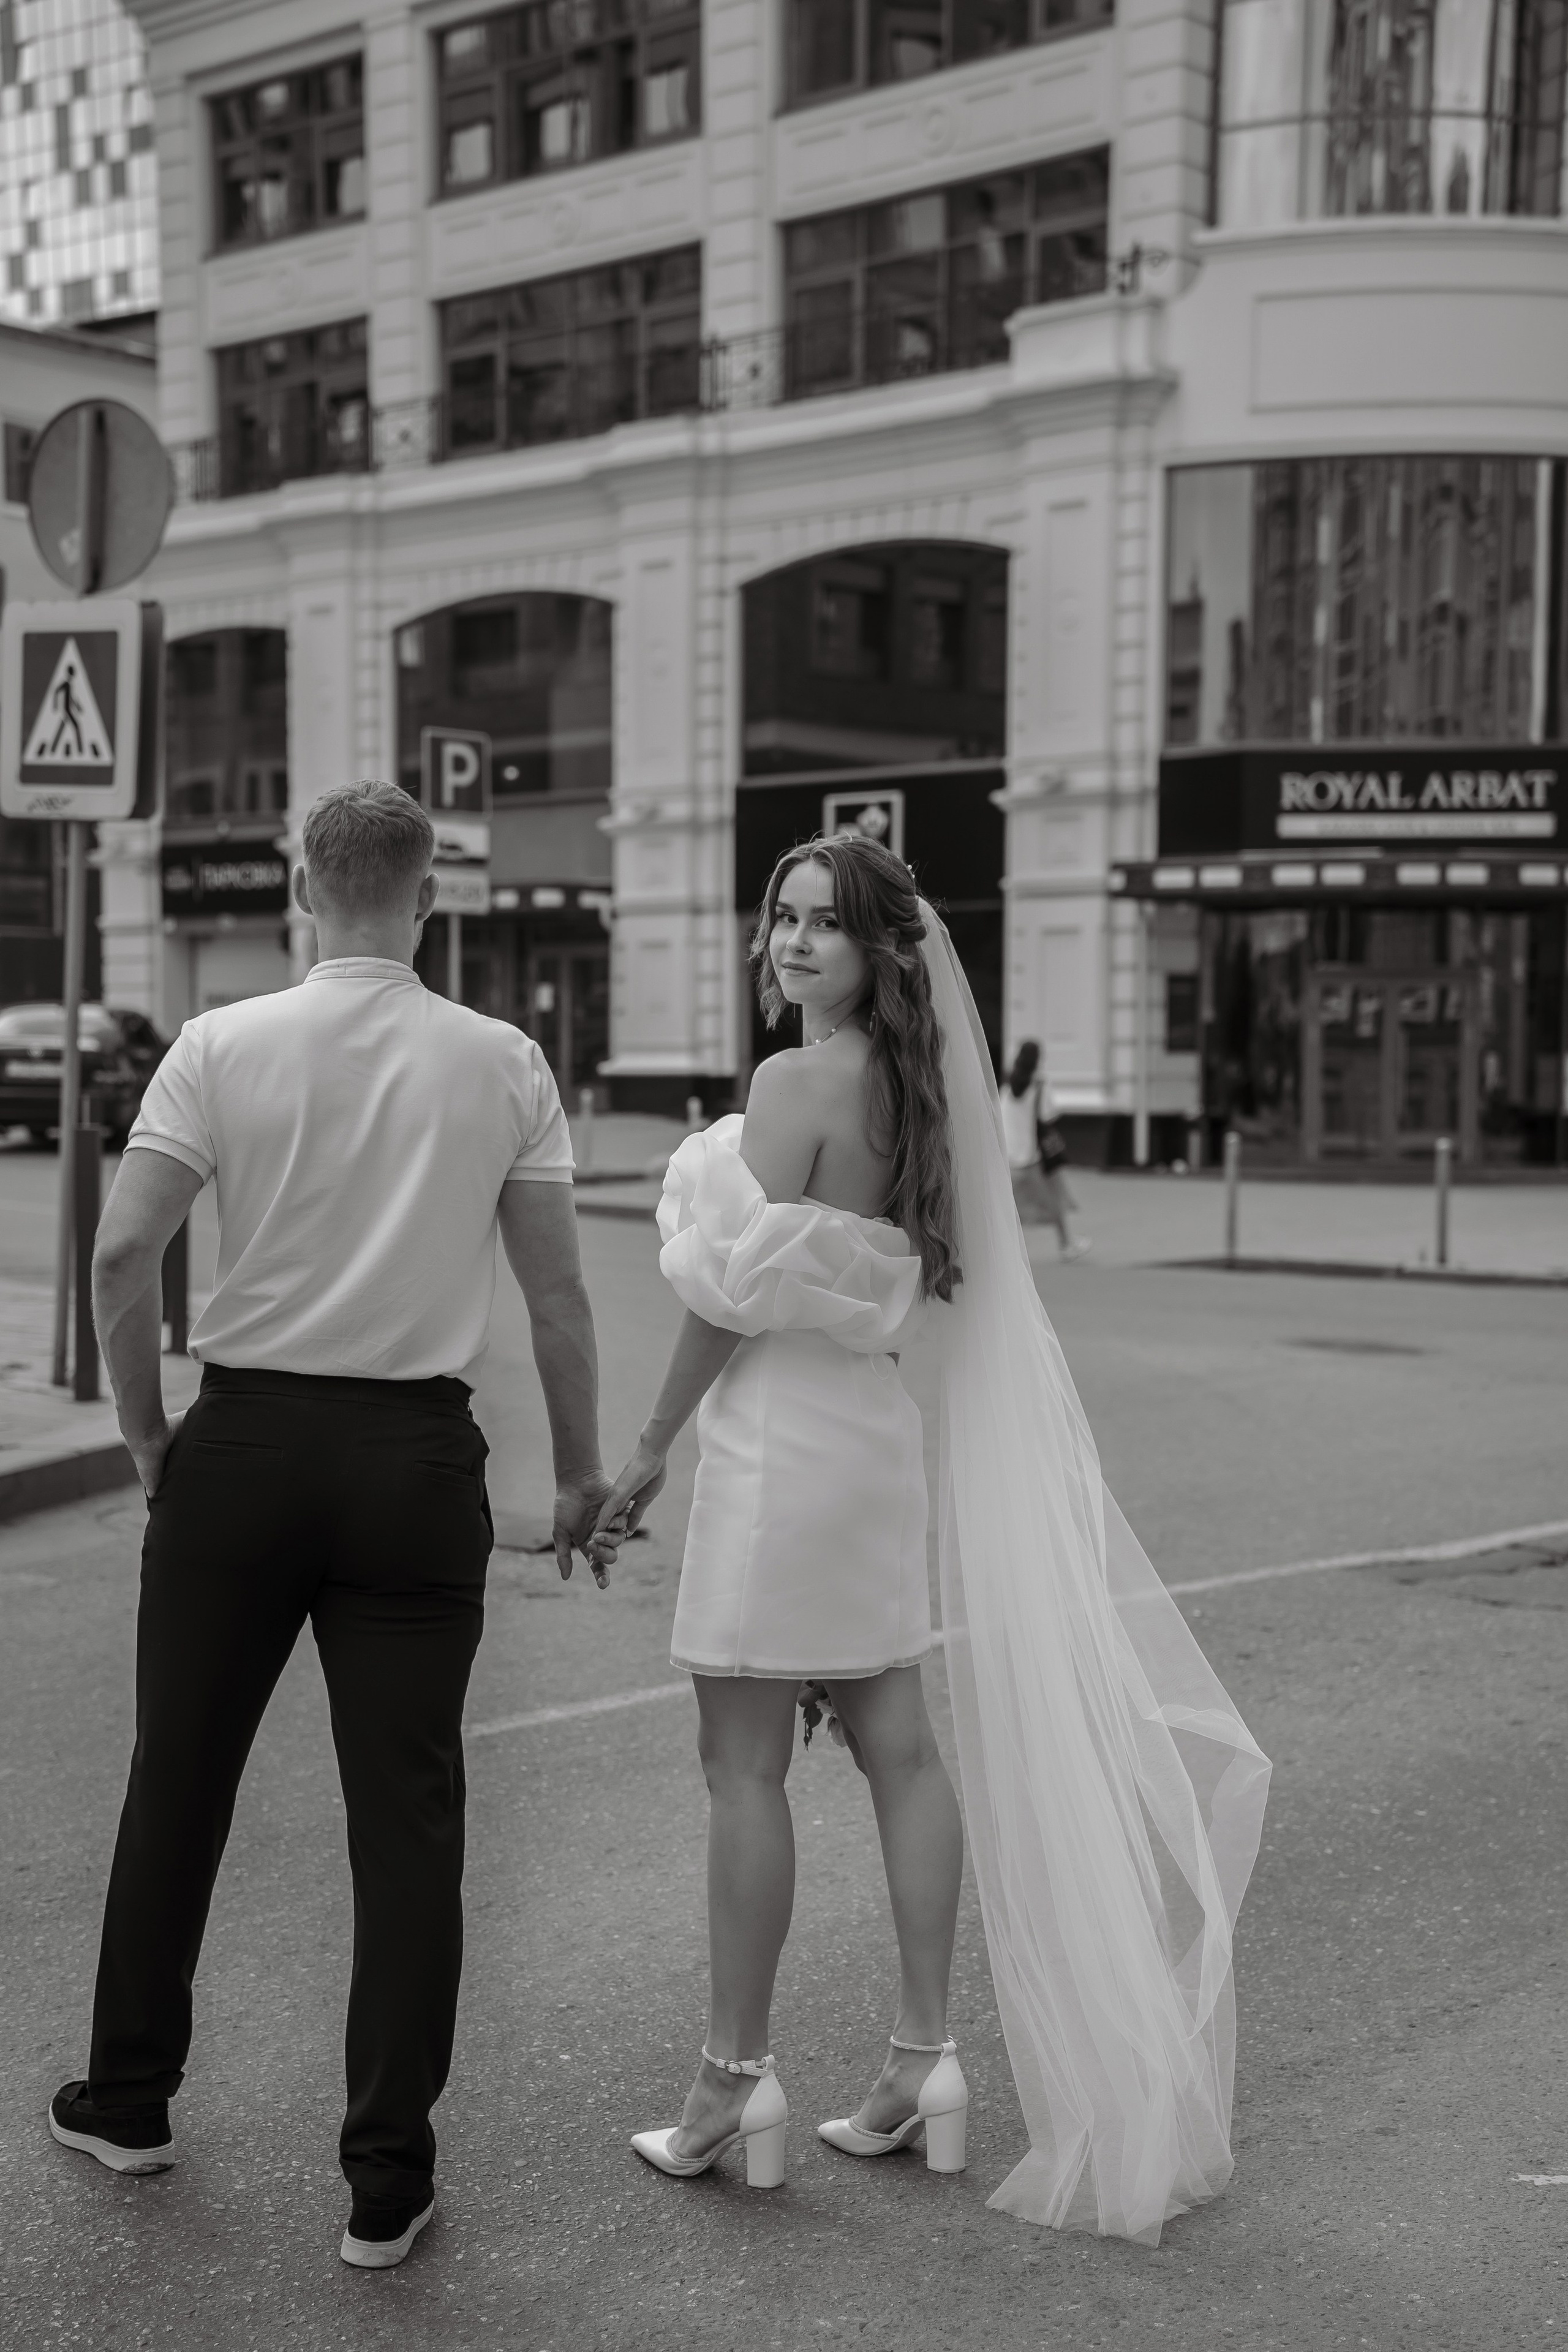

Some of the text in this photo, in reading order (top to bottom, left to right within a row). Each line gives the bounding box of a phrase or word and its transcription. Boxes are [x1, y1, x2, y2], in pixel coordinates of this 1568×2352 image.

[442, 742, 480, 807] P
[1280, 770, 1557, 810] ROYAL ARBAT
